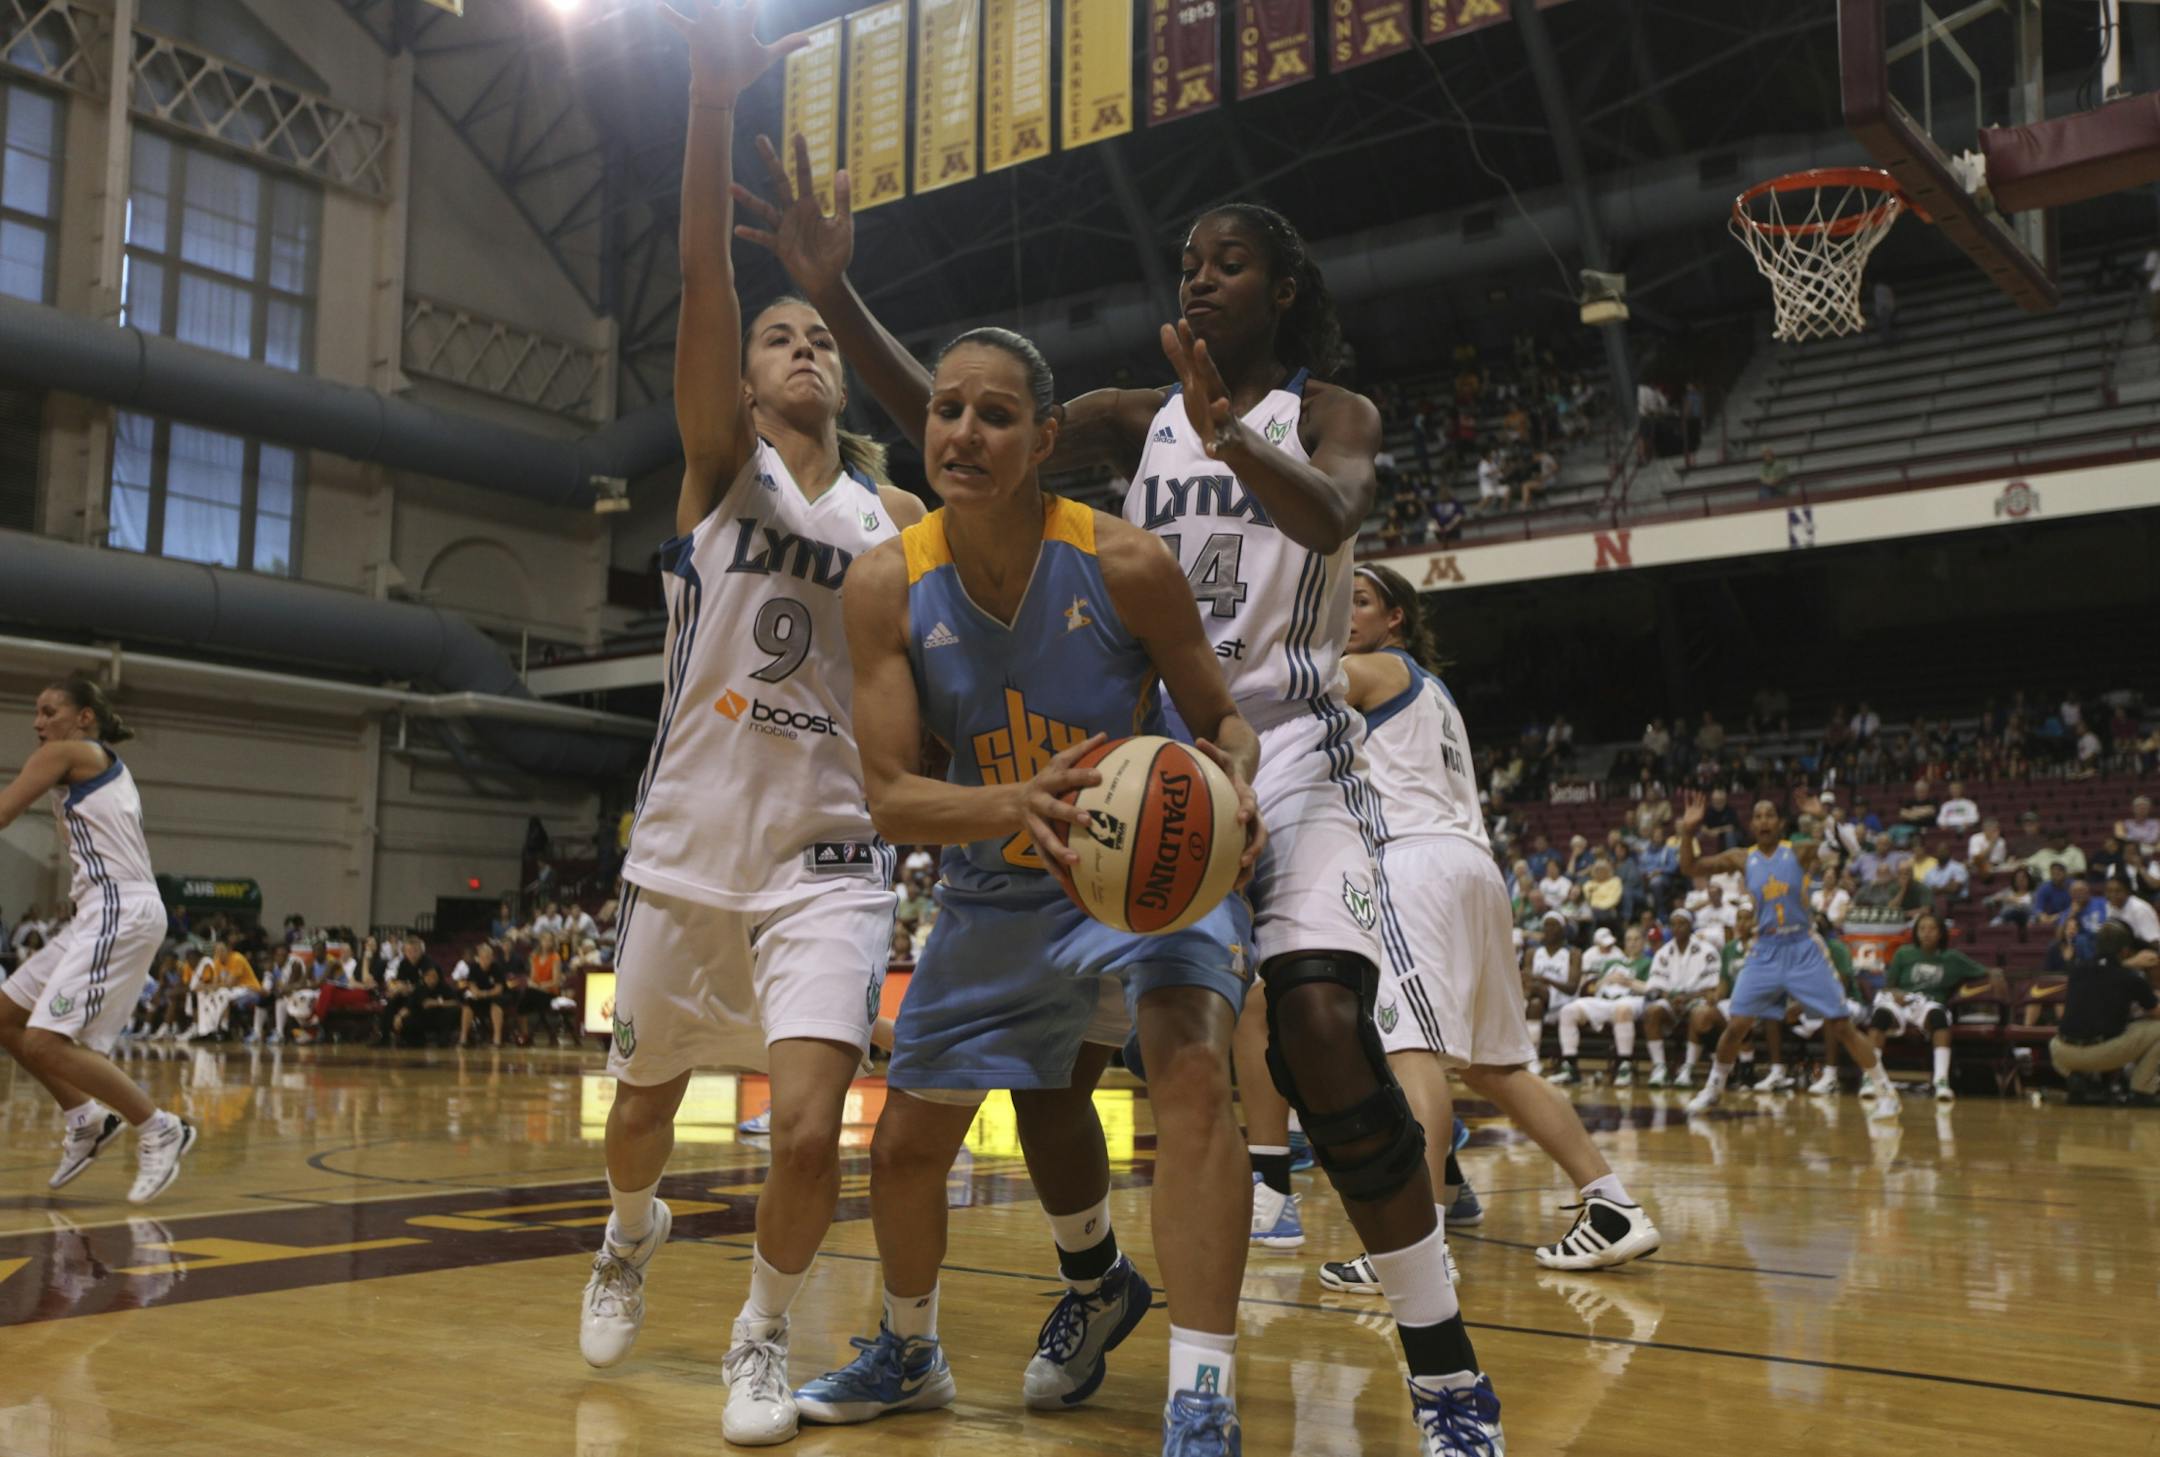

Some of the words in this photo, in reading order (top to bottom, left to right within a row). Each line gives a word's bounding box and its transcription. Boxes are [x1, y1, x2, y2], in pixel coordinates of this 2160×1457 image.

[1361, 18, 1405, 53] M
[1267, 50, 1308, 82] M
[1176, 77, 1215, 109] M
[1594, 530, 1632, 571] N
[1422, 556, 1466, 585] M
[748, 597, 812, 684] 9
[923, 636, 959, 648] adidas
[748, 722, 797, 741] mobile
[751, 699, 838, 735] boost
[1136, 771, 1192, 911] SPALDING
